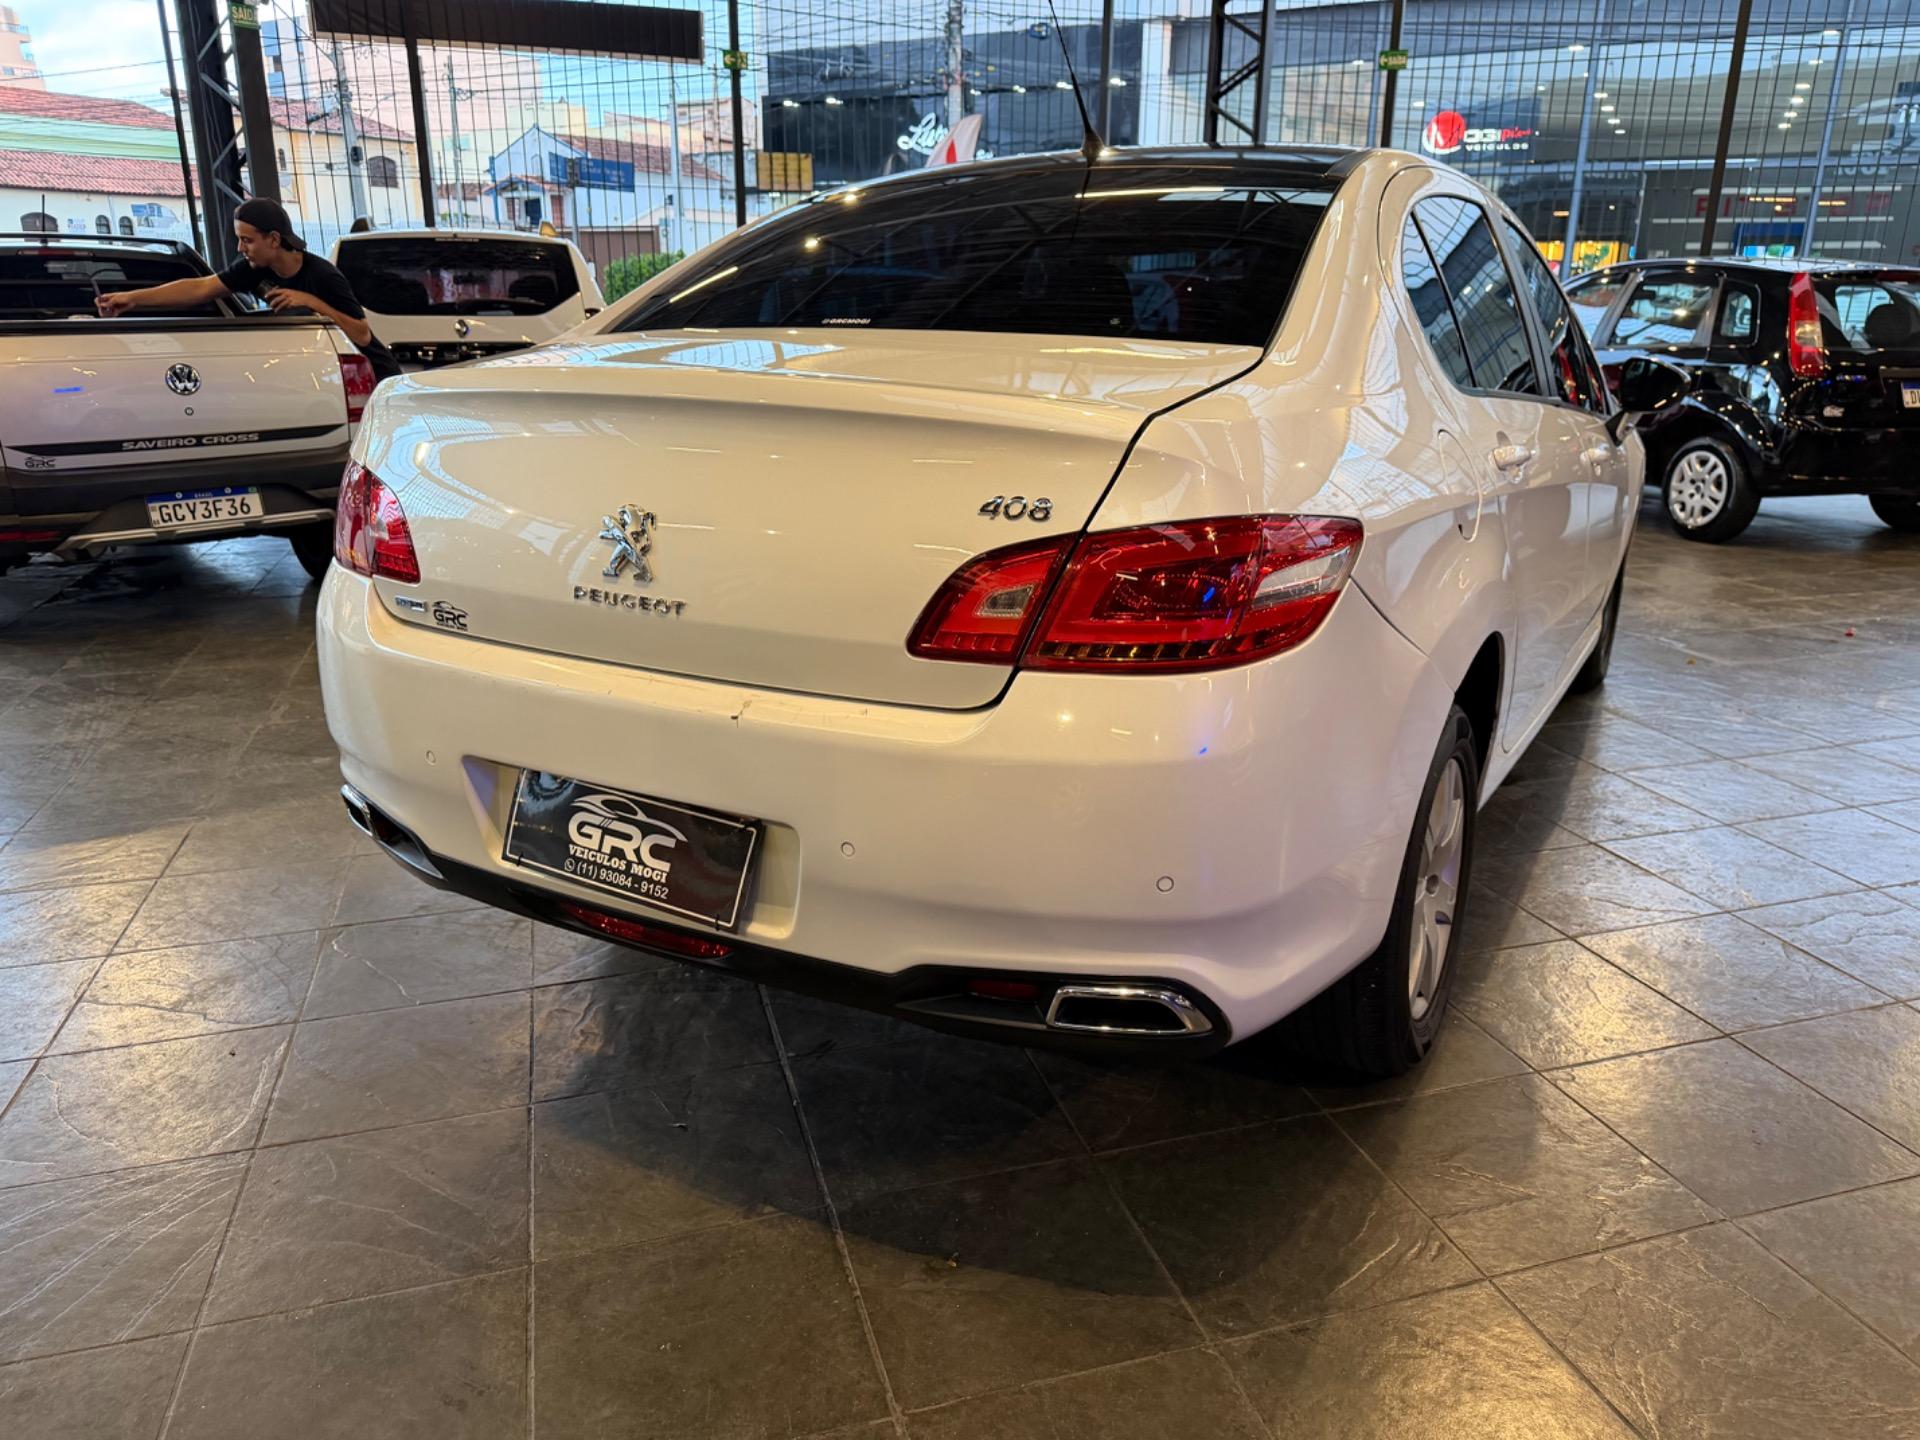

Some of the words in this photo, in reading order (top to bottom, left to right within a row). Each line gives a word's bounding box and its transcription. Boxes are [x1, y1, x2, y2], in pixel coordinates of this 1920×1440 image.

[122, 437, 197, 450] SAVEIRO
[202, 432, 259, 445] CROSS
[158, 497, 251, 524] GCY3F36
[978, 495, 1053, 521] 408
[573, 586, 686, 616] PEUGEOT
[433, 608, 468, 628] GRC
[568, 811, 677, 873] GRC
[568, 843, 627, 871] VEICULOS
[630, 862, 668, 884] MOGI
[577, 860, 598, 880] (11)
